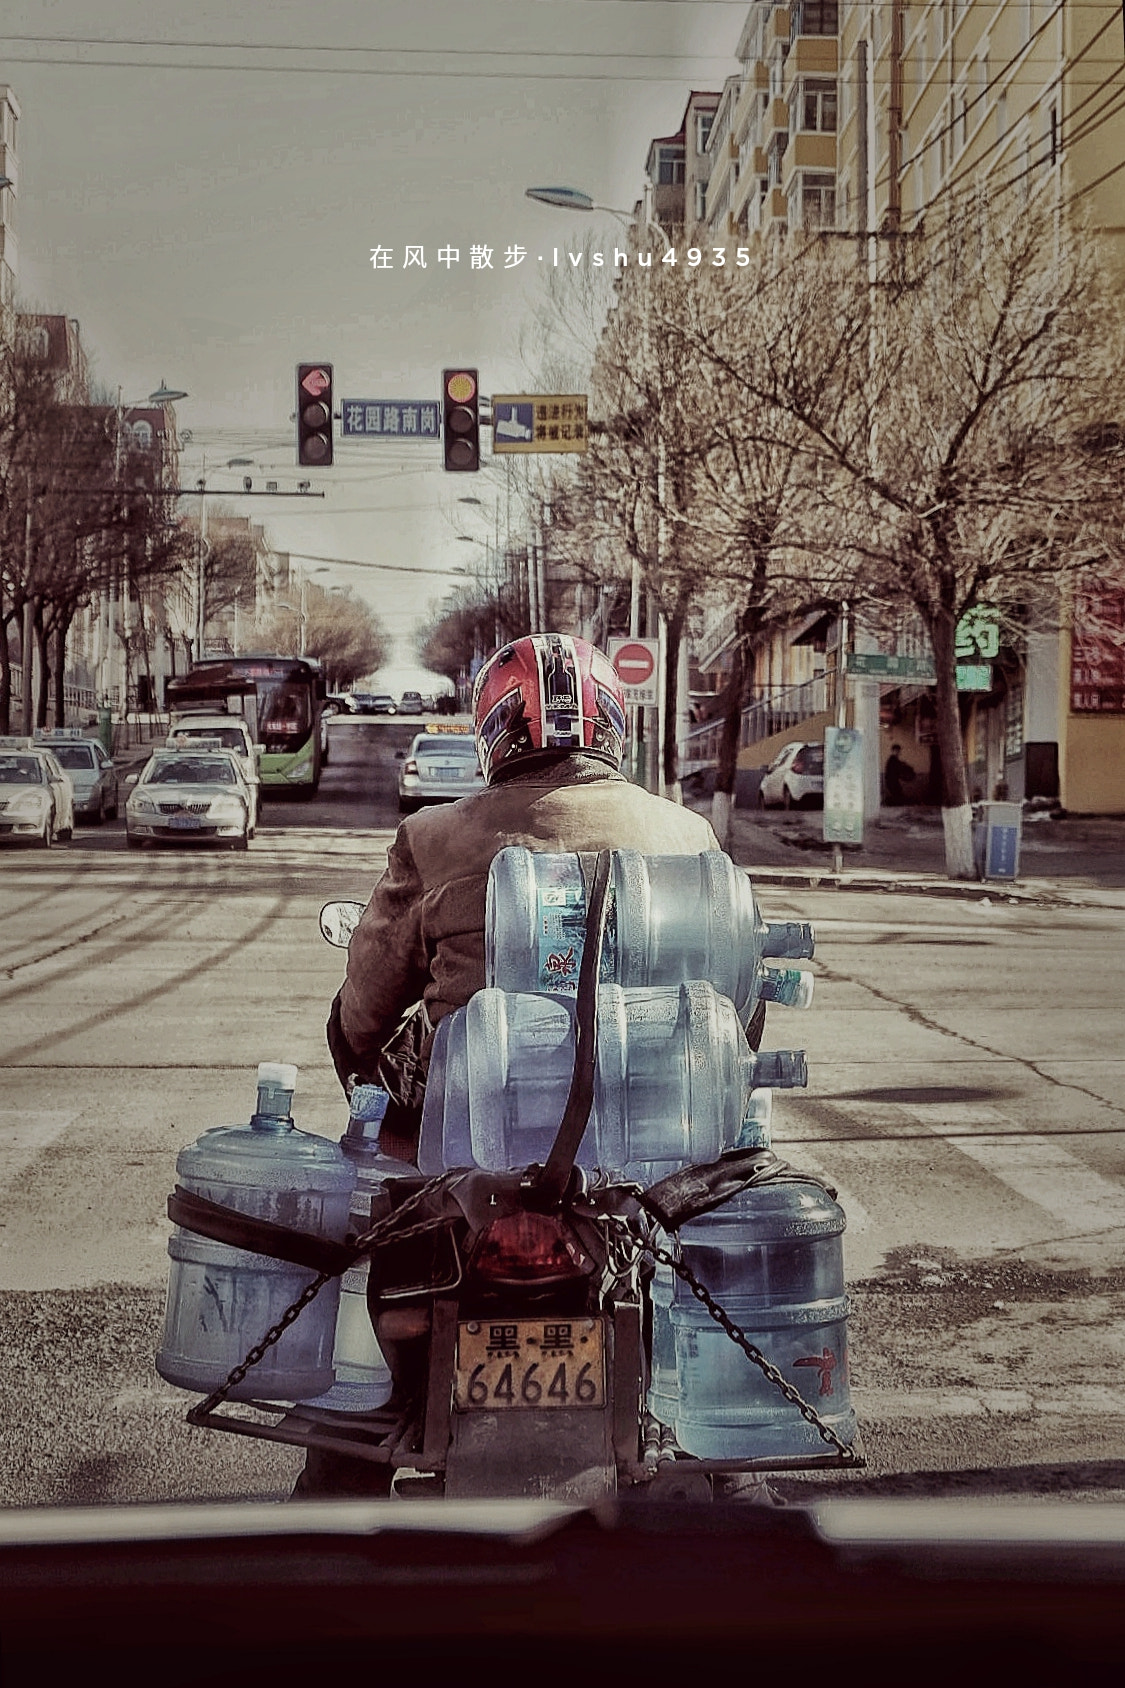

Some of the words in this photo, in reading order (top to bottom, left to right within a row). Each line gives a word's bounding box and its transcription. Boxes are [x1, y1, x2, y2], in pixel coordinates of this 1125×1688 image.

[346, 404, 436, 432] 花园路南岗
[467, 1362, 597, 1403] 64646
